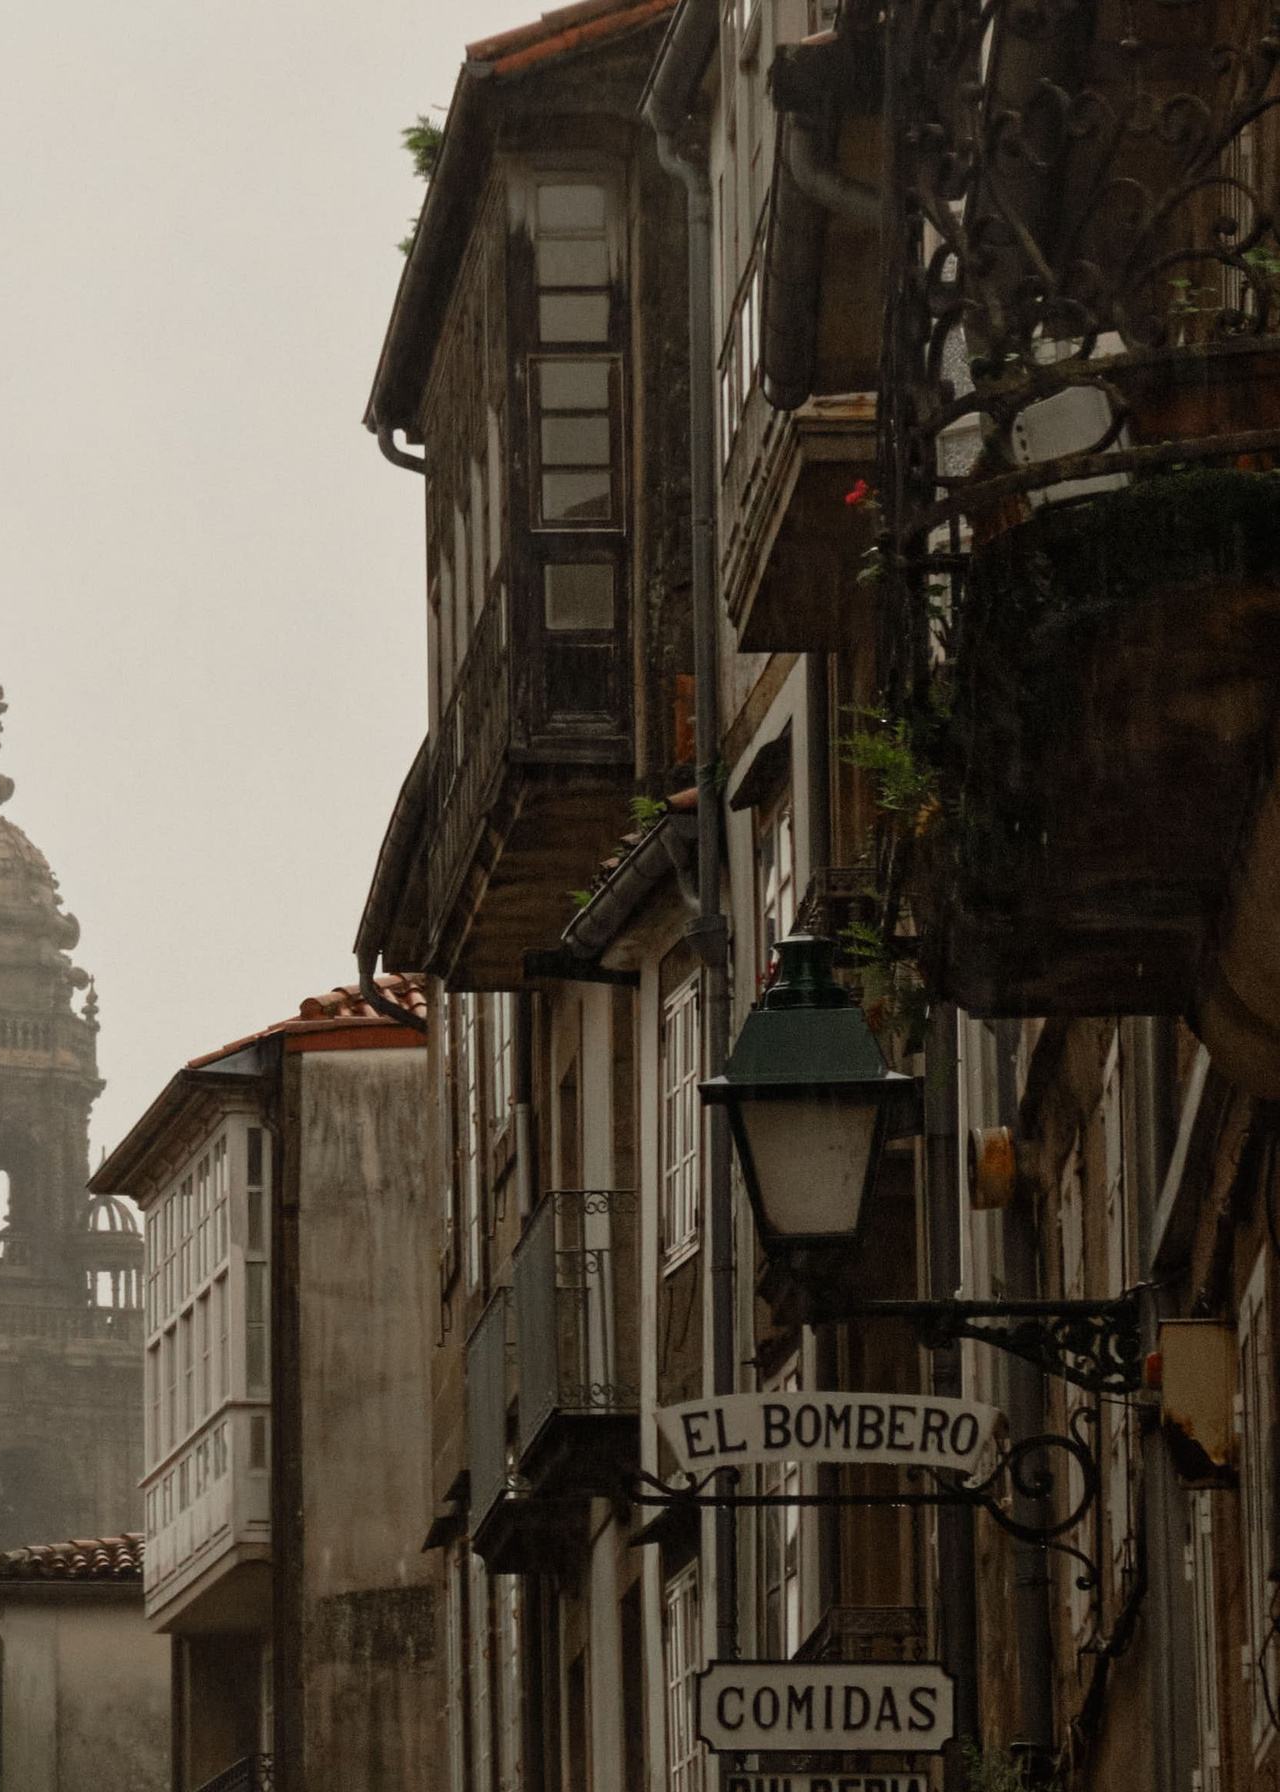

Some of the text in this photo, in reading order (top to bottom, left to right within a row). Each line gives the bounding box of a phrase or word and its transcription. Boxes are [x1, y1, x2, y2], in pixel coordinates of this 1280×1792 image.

[681, 1404, 981, 1458] EL BOMBERO
[717, 1685, 938, 1732] COMIDAS
